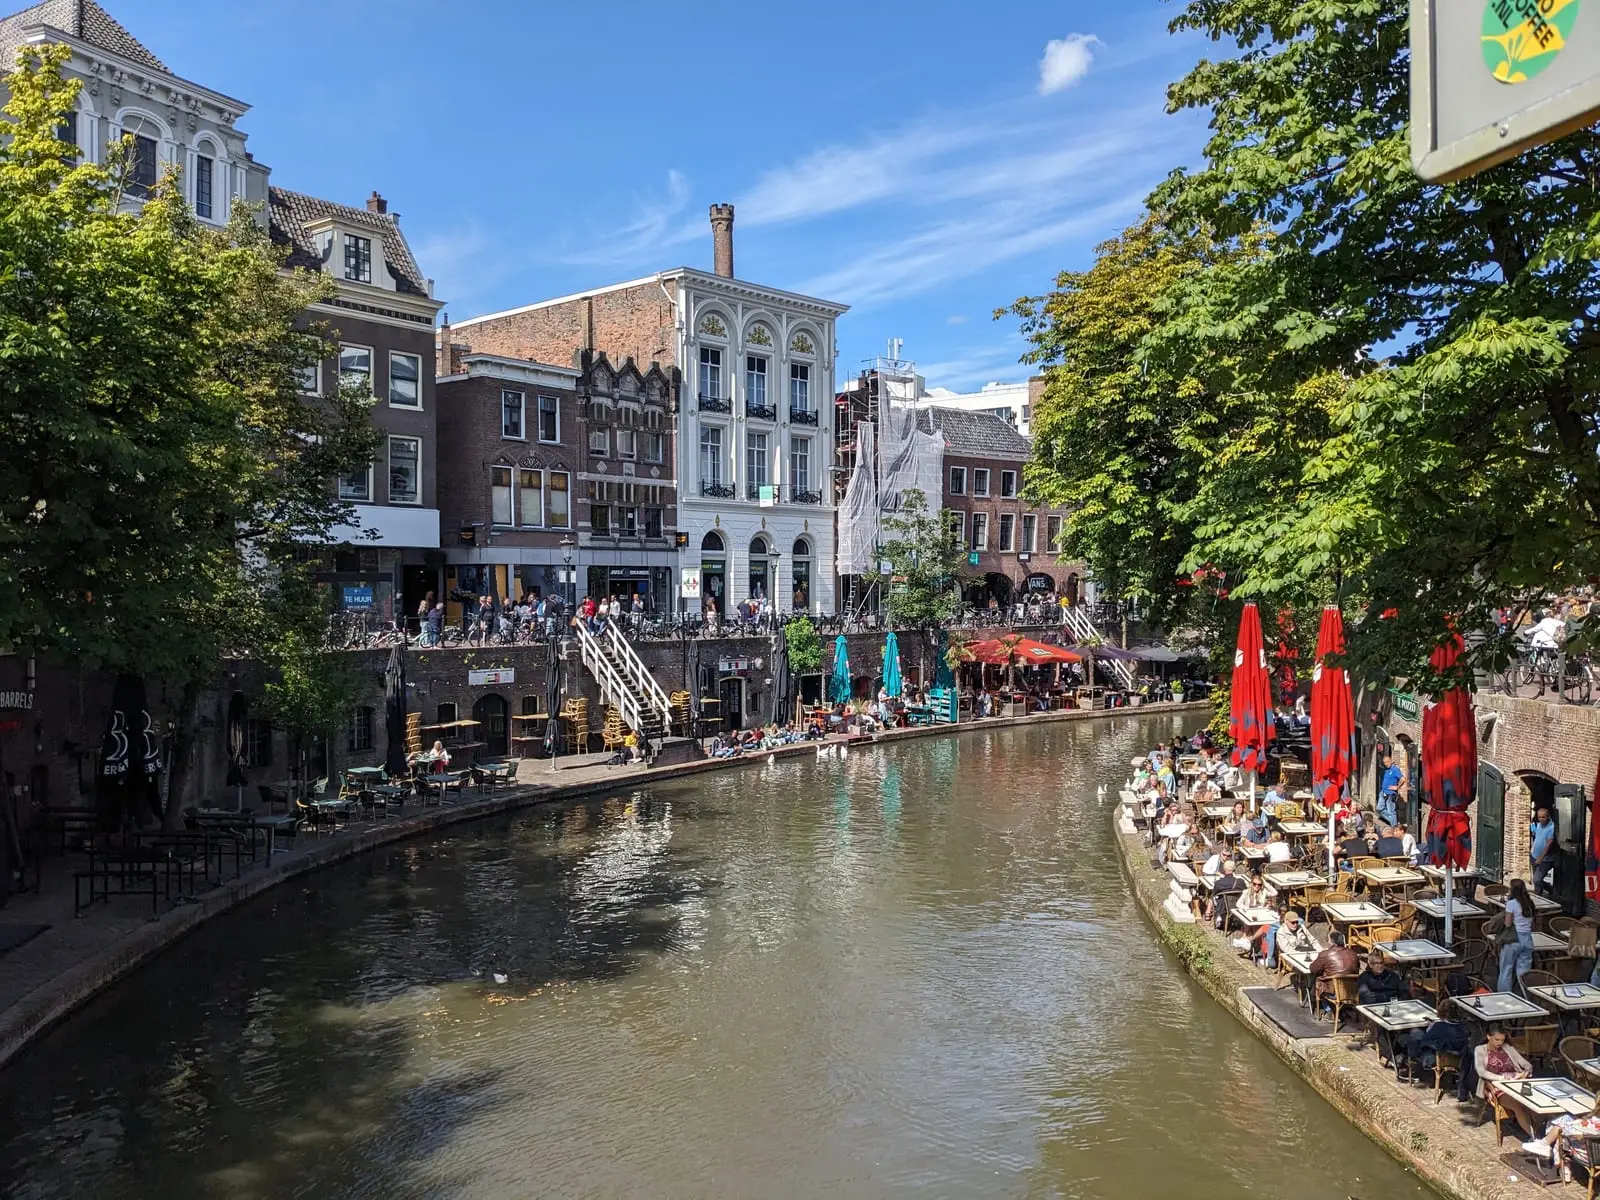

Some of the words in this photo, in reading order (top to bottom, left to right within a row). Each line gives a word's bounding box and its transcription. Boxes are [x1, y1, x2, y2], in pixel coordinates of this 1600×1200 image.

[1511, 0, 1555, 49] OFFEE
[1027, 577, 1046, 591] VANS
[0, 691, 34, 710] BARRELS
